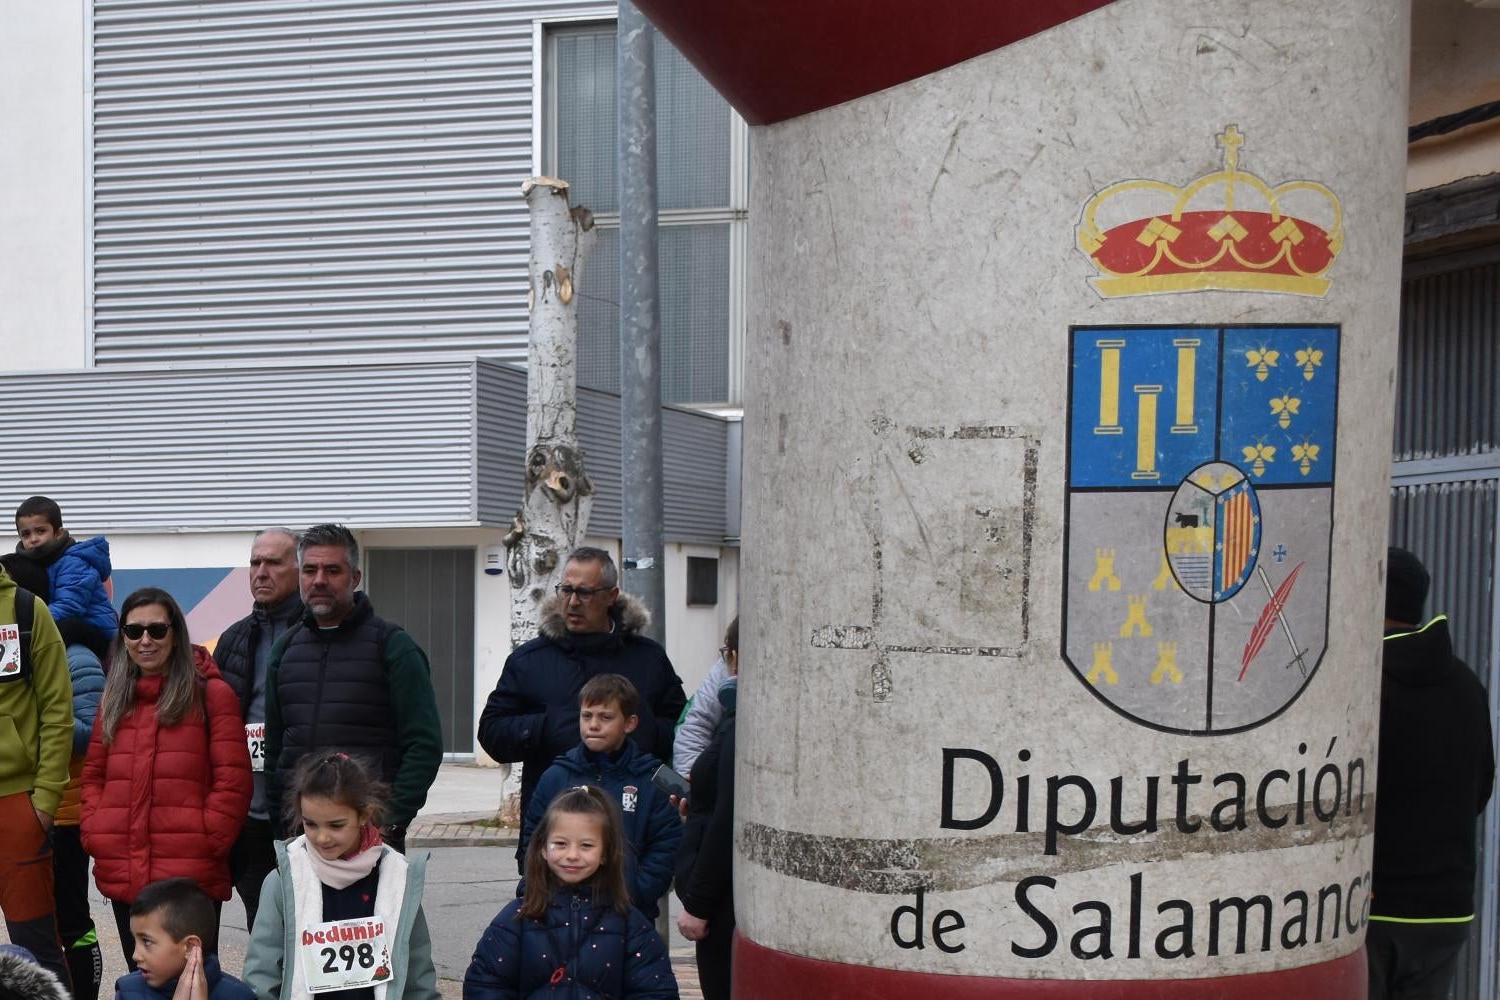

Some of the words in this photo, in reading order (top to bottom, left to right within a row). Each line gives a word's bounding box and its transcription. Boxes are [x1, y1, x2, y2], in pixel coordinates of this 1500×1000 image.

[251, 740, 265, 759] 25
[939, 736, 1365, 856] Diputación
[302, 921, 384, 946] bedunia
[890, 885, 967, 954] de
[320, 942, 375, 974] 298
